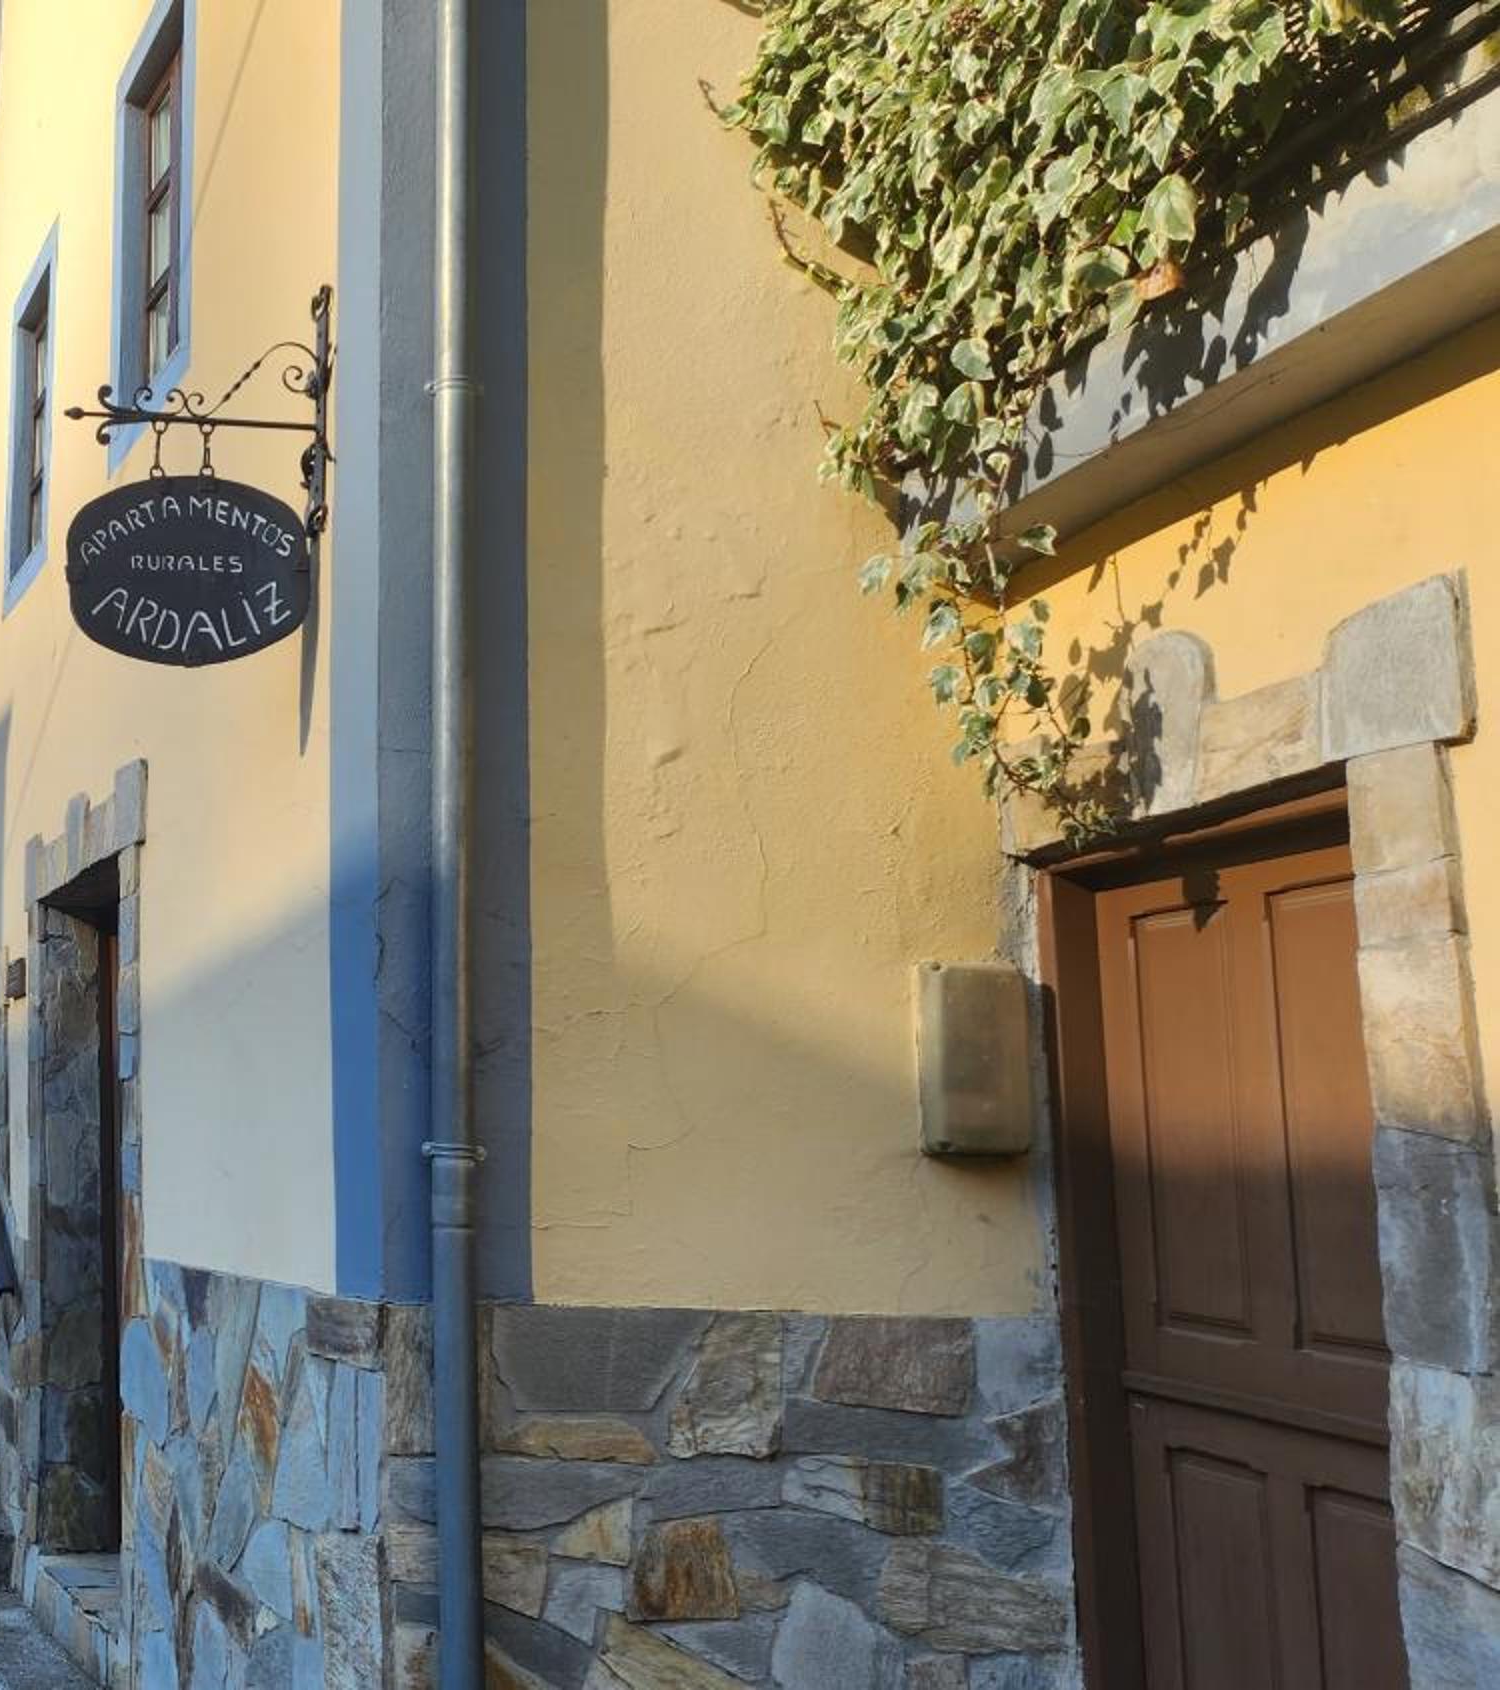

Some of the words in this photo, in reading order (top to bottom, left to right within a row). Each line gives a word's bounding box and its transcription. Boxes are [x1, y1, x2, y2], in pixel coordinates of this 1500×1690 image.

[80, 495, 295, 566] APARTAMENTOS
[131, 555, 243, 573] RURALES
[91, 581, 291, 652] ARDALIZ
